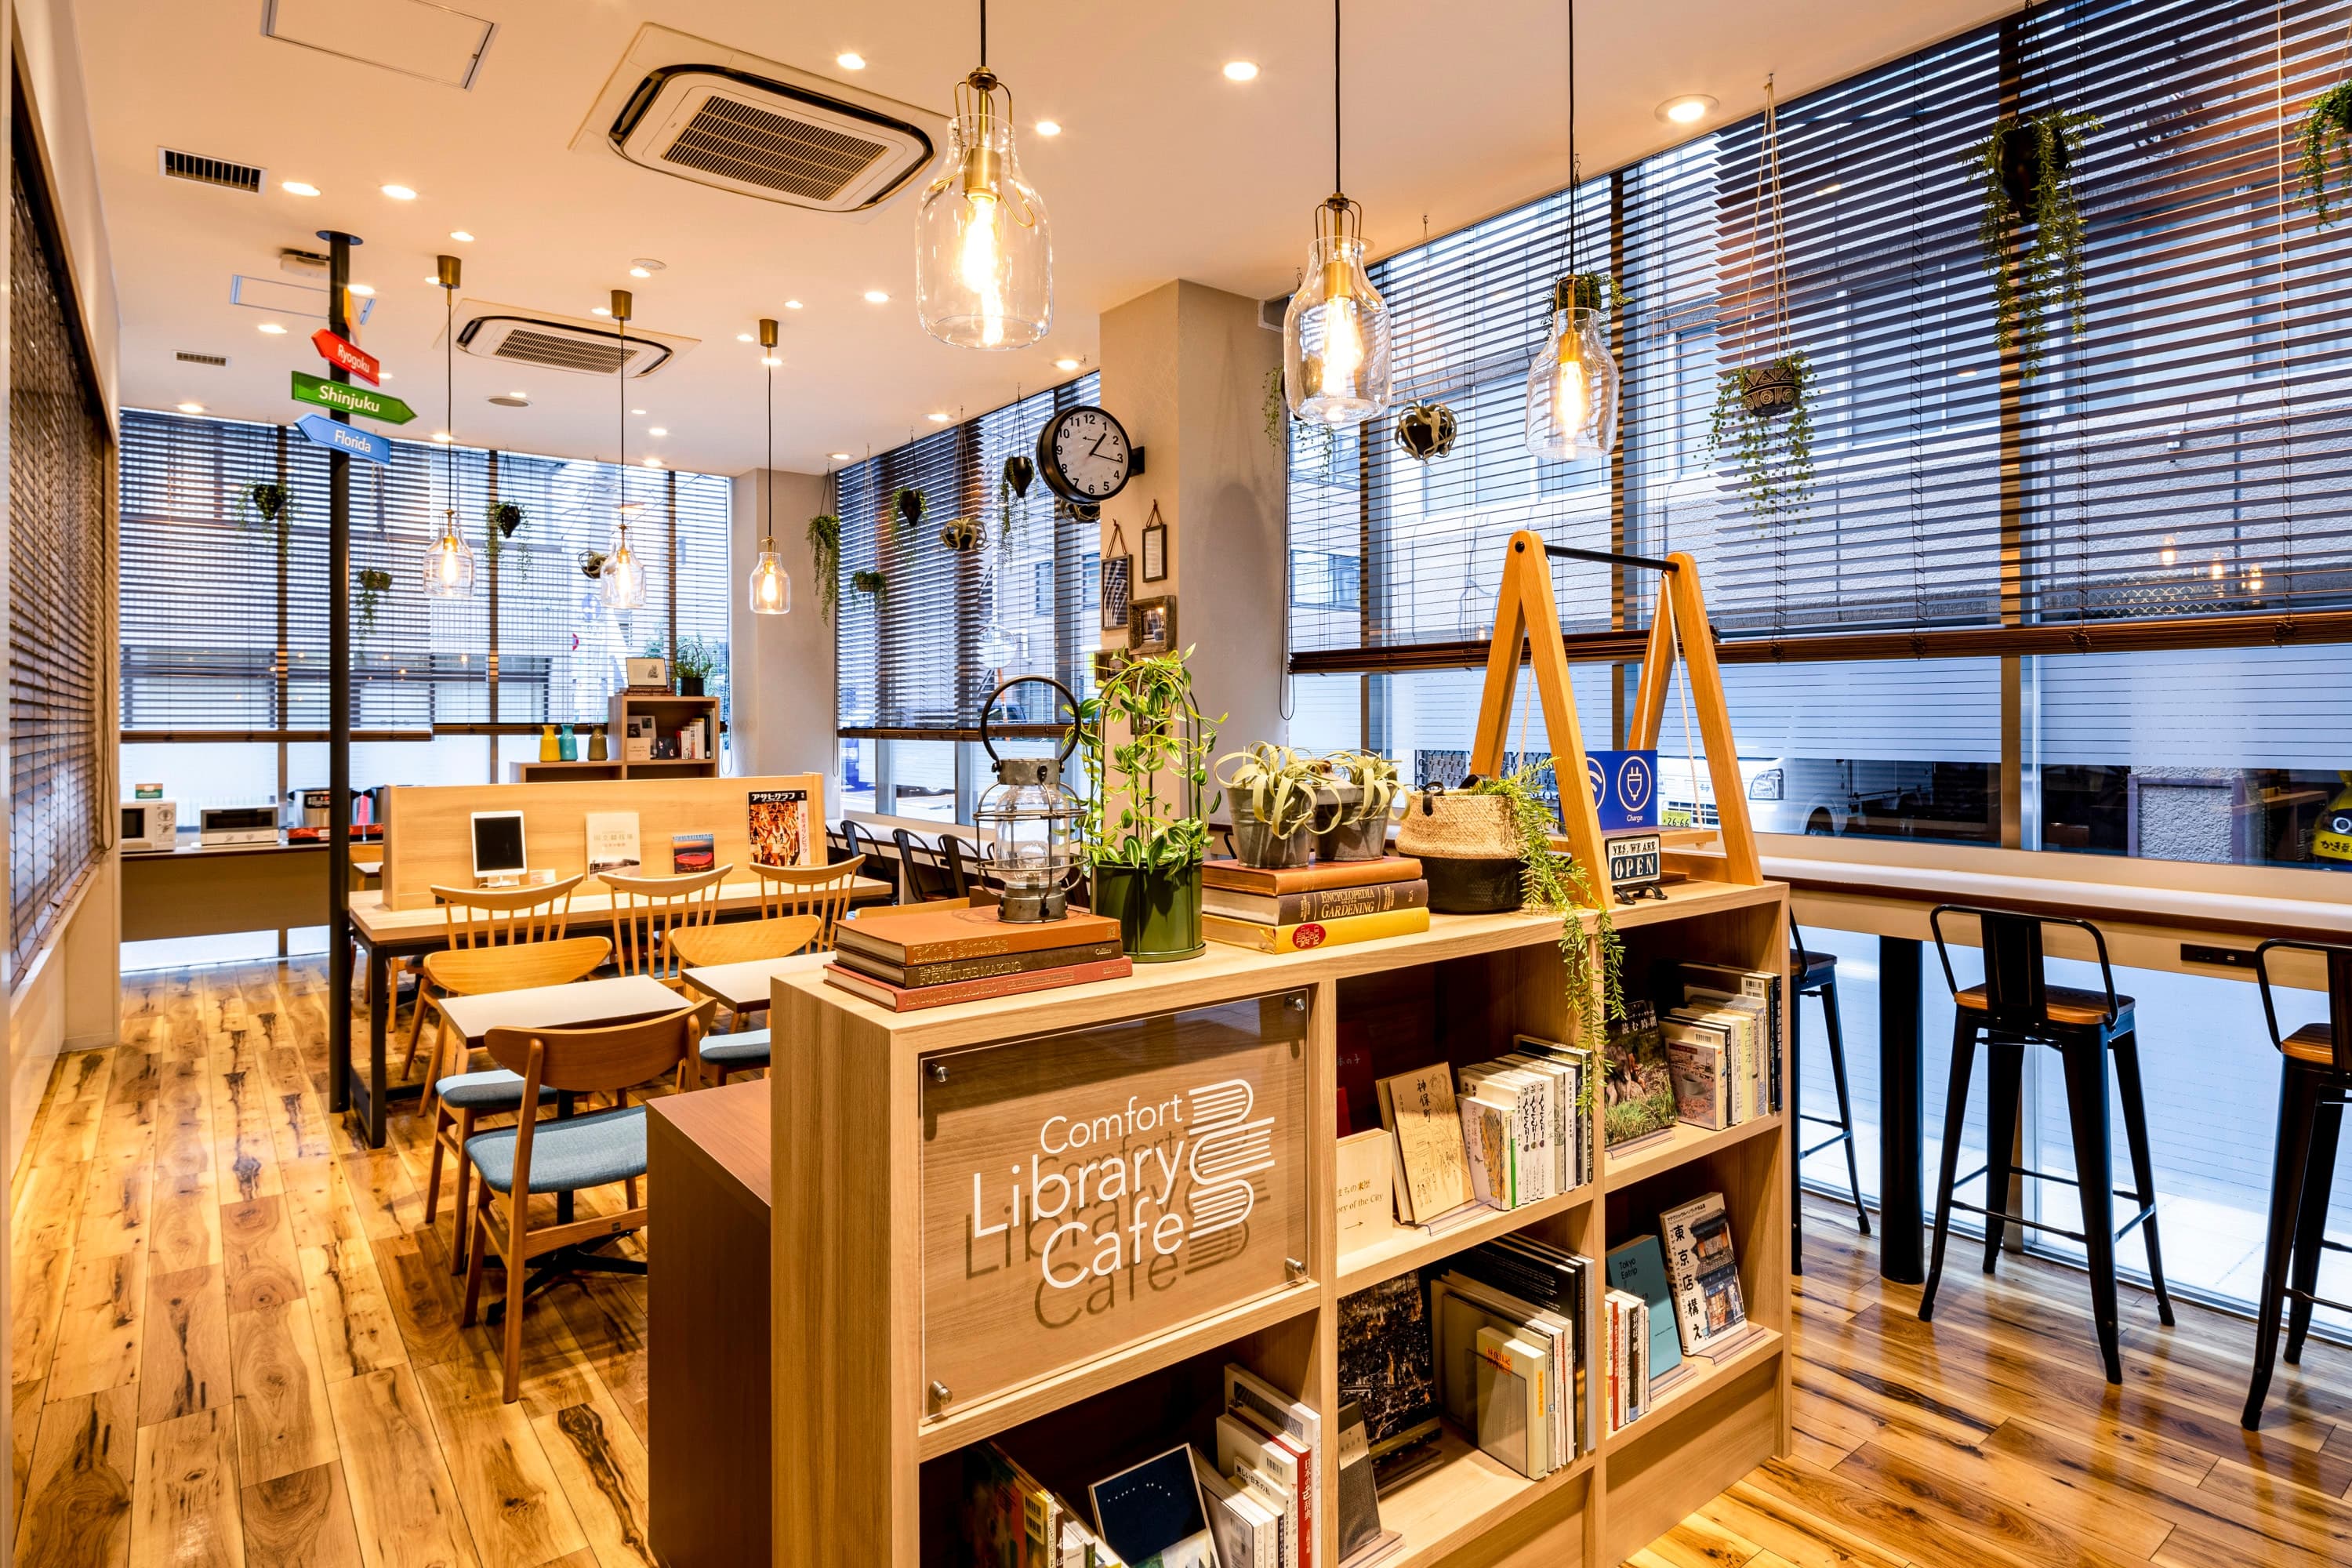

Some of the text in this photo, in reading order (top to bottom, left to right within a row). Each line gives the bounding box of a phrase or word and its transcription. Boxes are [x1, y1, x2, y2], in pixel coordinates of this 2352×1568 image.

[338, 344, 370, 373] Ryogoku
[318, 385, 379, 412] Shinjuku
[1069, 416, 1080, 426] 11
[1083, 414, 1095, 424] 12
[1102, 422, 1107, 430] 1
[1058, 429, 1069, 438] 10
[335, 430, 372, 452] Florida
[1112, 436, 1119, 445] 2
[1056, 445, 1062, 455] 9
[1117, 454, 1123, 463] 3
[1062, 464, 1068, 474] 8
[1114, 470, 1120, 479] 4
[1073, 478, 1080, 488] 7
[1103, 481, 1109, 491] 5
[1088, 485, 1094, 494] 6
[1626, 814, 1643, 822] Charge
[1631, 843, 1641, 853] WE
[1642, 841, 1656, 851] ARE
[1615, 855, 1654, 879] OPEN
[1321, 887, 1375, 903] ENCYCLOPEDIA
[1321, 902, 1374, 918] GARDENING
[920, 960, 1022, 985] FURNITURE MAKING
[1417, 1079, 1432, 1123] 神保町
[1040, 1094, 1182, 1154] Comfort
[973, 1140, 1185, 1239] Library
[1359, 1199, 1369, 1207] the
[1042, 1196, 1185, 1289] Cafe
[1618, 1258, 1636, 1270] Tokyo
[1674, 1224, 1703, 1341] 東京店構え
[1302, 1458, 1312, 1520] 日本の色辞典
